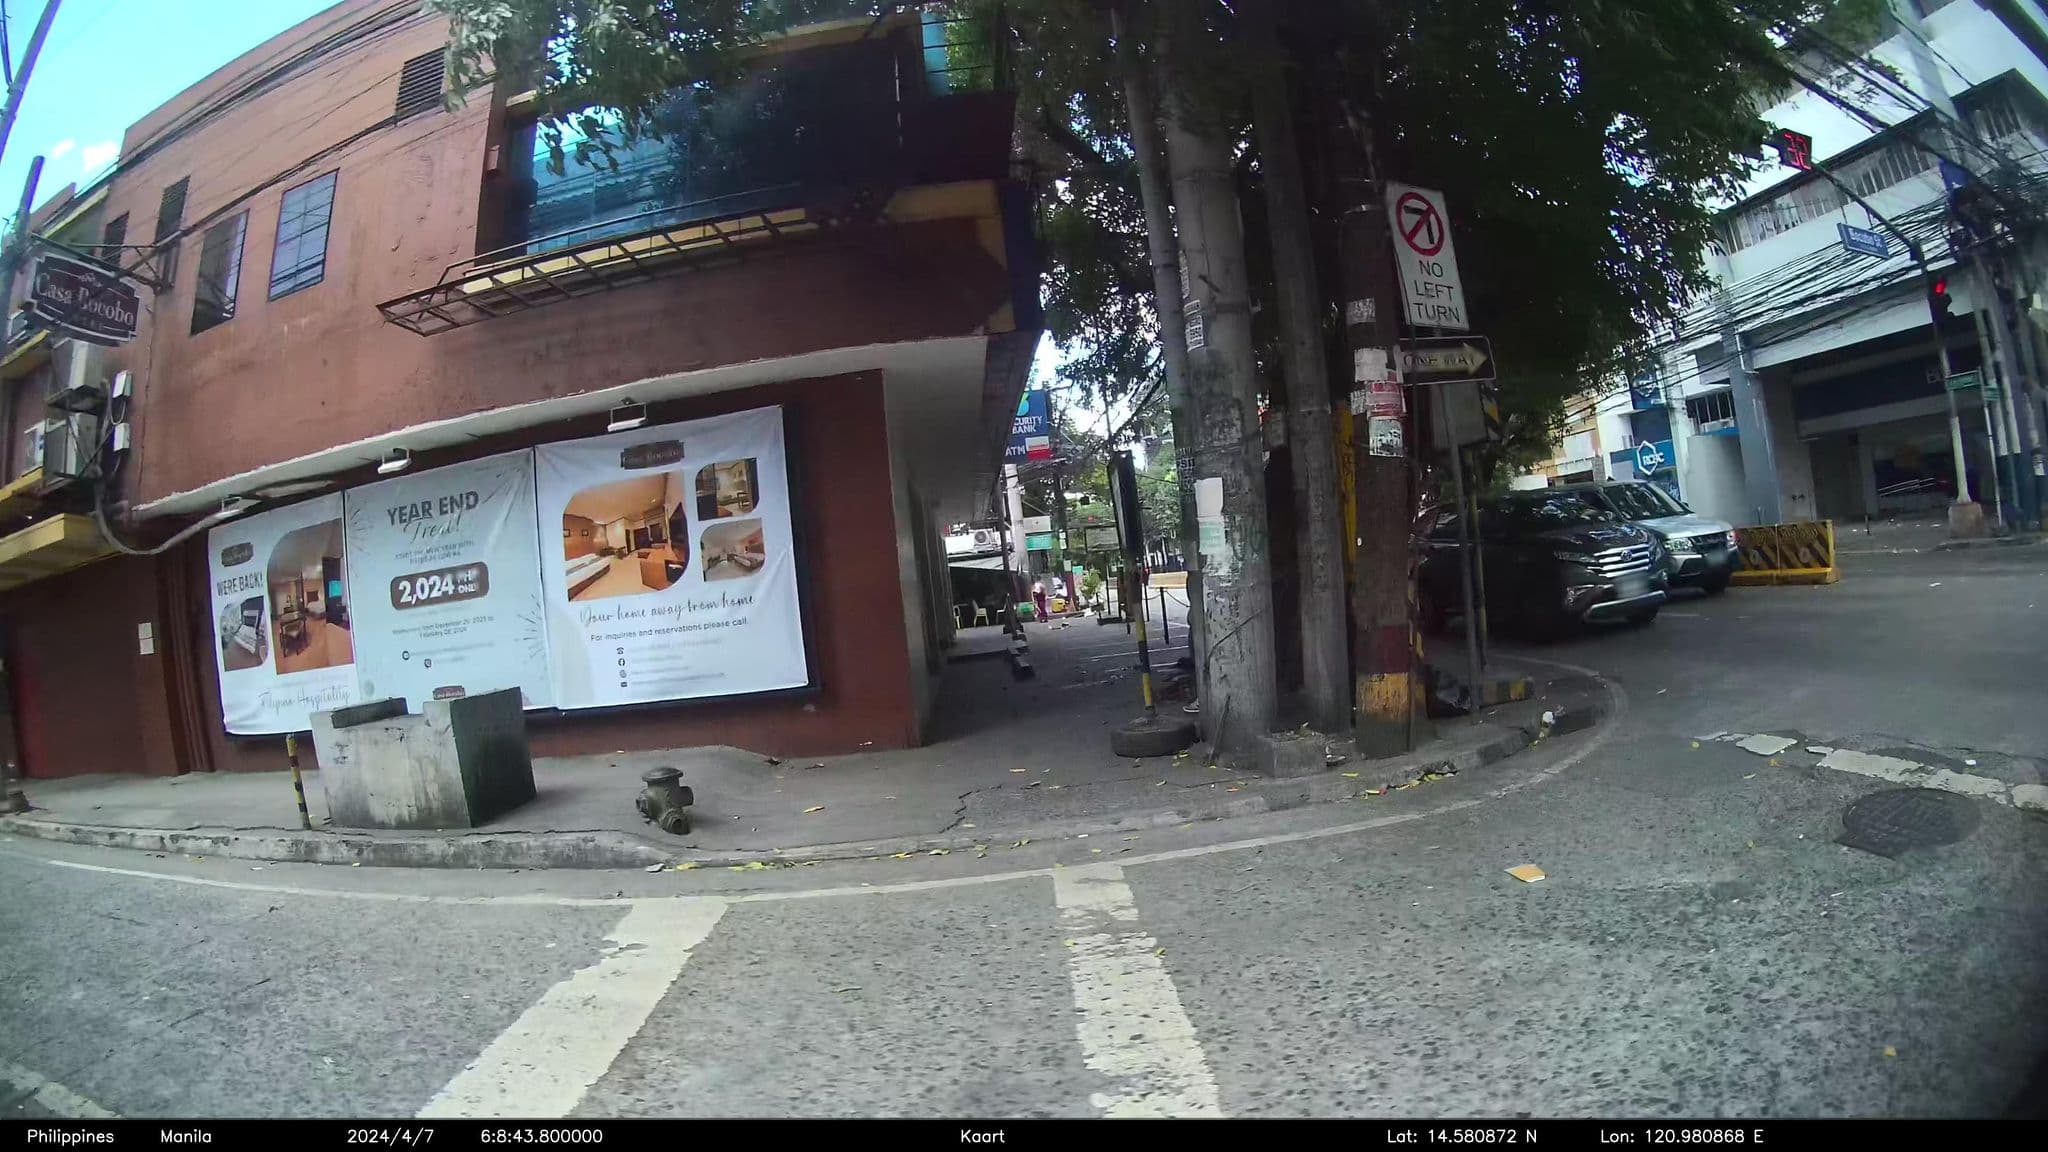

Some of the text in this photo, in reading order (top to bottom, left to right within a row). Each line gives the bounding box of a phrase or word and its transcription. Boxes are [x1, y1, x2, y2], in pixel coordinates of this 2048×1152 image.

[1419, 260, 1444, 278] NO
[36, 273, 73, 305] Casa
[78, 287, 135, 326] Bocobo
[1414, 280, 1454, 302] LEFT
[1413, 302, 1461, 323] TURN
[1403, 353, 1438, 367] ONE
[1012, 425, 1037, 434] BANK
[1014, 416, 1043, 426] CURITY
[1005, 445, 1026, 457] ATM
[387, 490, 480, 527] YEAR END
[398, 574, 455, 605] 2,024
[722, 591, 755, 609] home
[590, 633, 603, 642] For
[605, 630, 637, 641] inquiries
[638, 628, 653, 637] and
[654, 623, 702, 636] reservations
[703, 620, 730, 631] please
